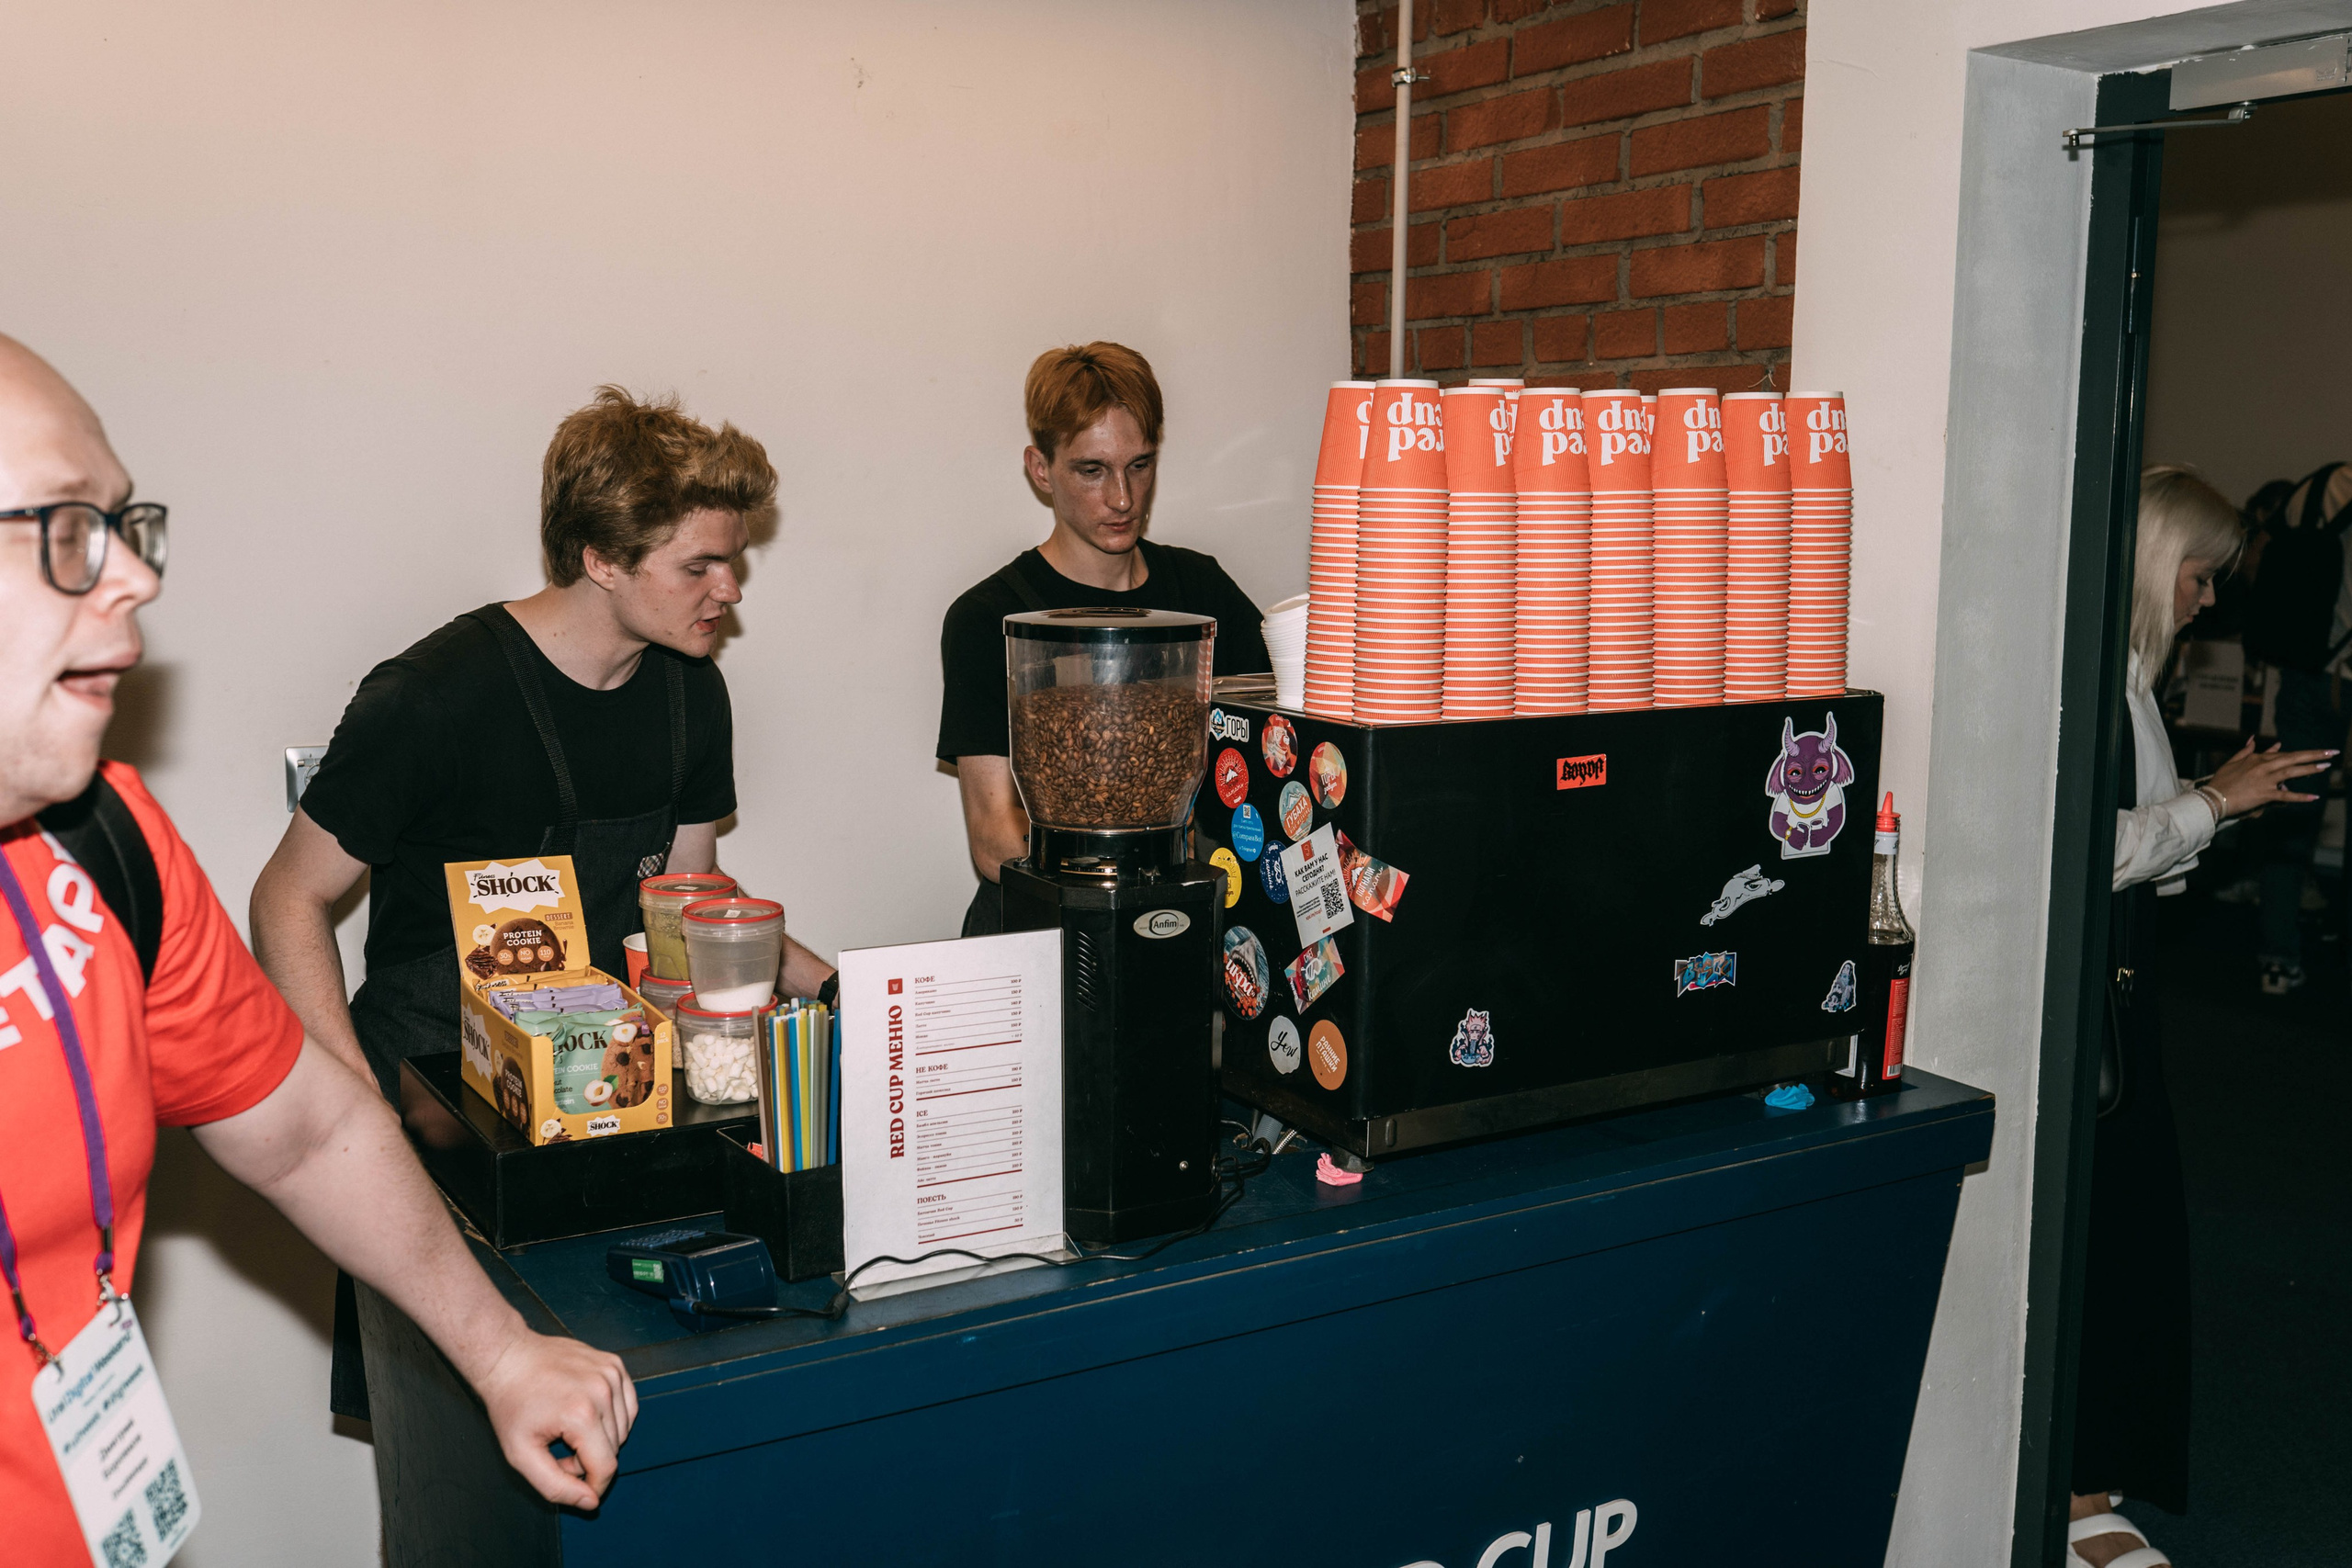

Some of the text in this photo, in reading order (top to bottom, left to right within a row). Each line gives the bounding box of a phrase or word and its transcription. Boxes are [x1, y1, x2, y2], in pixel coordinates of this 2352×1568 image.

[1539, 399, 1583, 431] up
[1683, 399, 1722, 429] up
[1806, 401, 1847, 431] up
[1686, 431, 1724, 464] ed
[1808, 432, 1849, 464] ed
[1227, 717, 1248, 739] ГОРЫ
[1286, 797, 1308, 828] ГУБАХА
[1295, 868, 1305, 877] КАК
[1305, 863, 1315, 874] ВАМ
[1318, 852, 1329, 863] НАС
[1302, 865, 1325, 882] СЕГОДНЯ?
[477, 875, 554, 897] SHOCK
[1295, 877, 1324, 897] РАССКАЖИТЕ
[1356, 866, 1375, 897] ПОГНАЛИ
[503, 930, 542, 940] PROTEIN
[1153, 919, 1177, 929] Anfim
[506, 937, 541, 947] COOKIE
[915, 976, 935, 984] КОФЕ
[1226, 959, 1253, 997] икра
[463, 1020, 490, 1061] SHOCK
[1320, 1036, 1340, 1066] РАННИЕ
[567, 1063, 598, 1073] COOKIE
[928, 1064, 948, 1072] КОФЕ
[1316, 1041, 1338, 1073] ПТАШКИ
[888, 1005, 905, 1158] RED CUP МЕНЮ
[589, 1121, 618, 1131] SHOCK
[917, 1194, 946, 1204] ПОЕСТЬ
